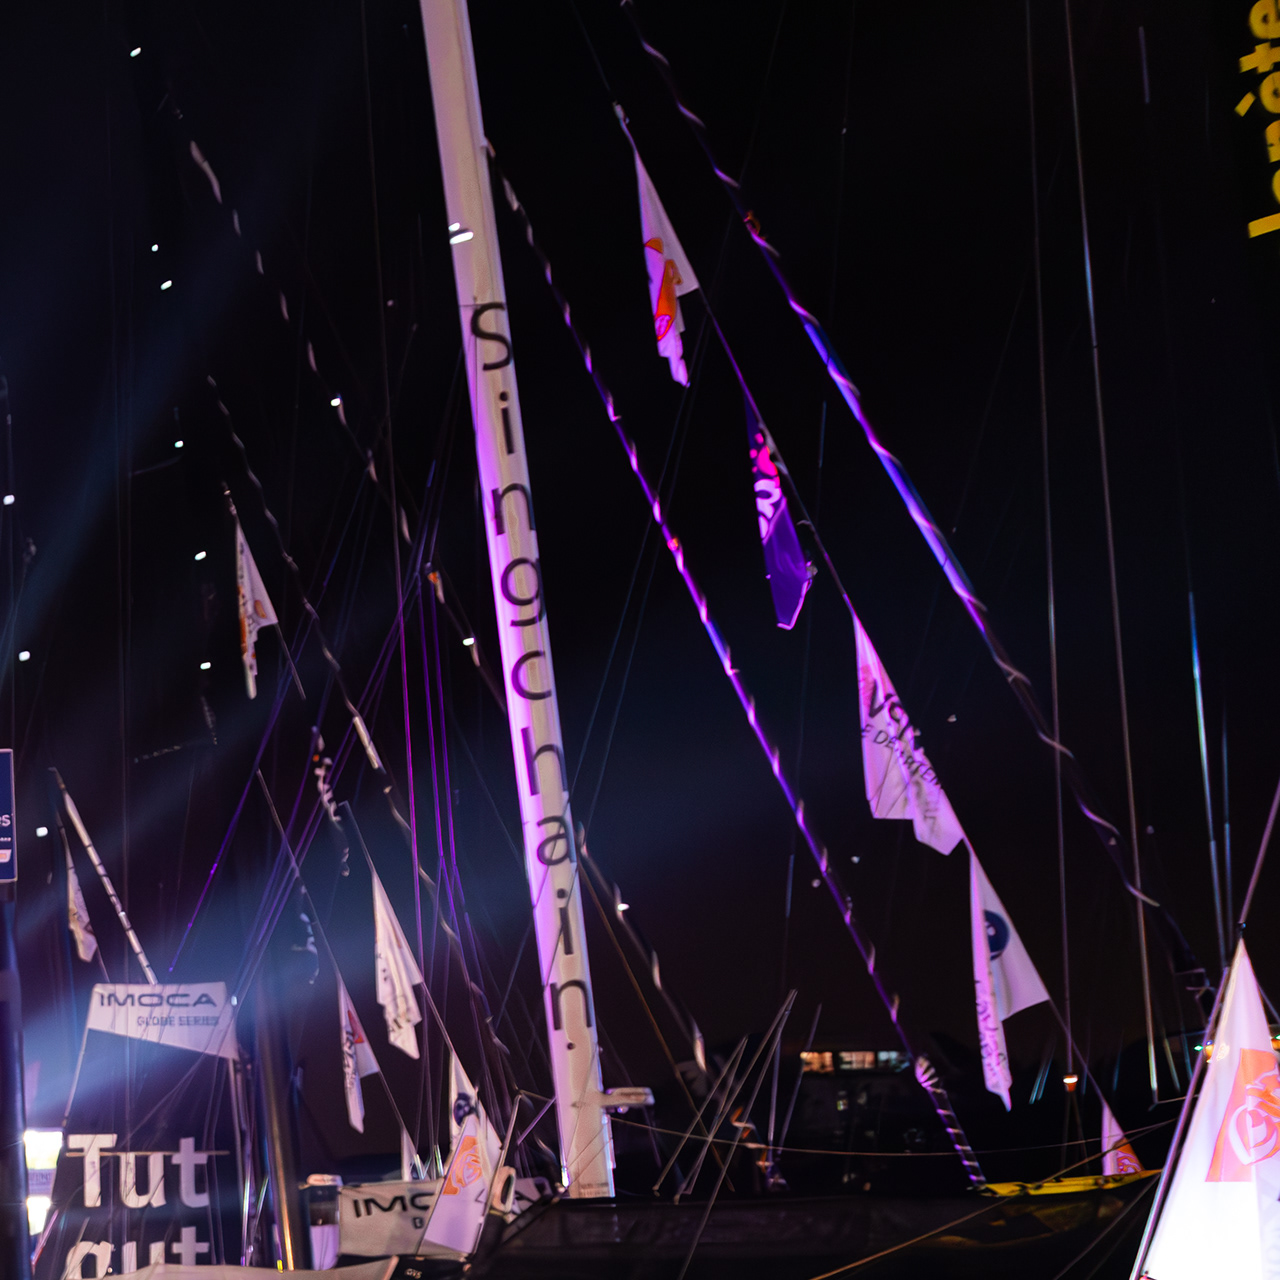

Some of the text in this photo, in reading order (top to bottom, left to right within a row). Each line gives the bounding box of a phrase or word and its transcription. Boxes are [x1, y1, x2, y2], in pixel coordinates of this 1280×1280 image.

[471, 302, 595, 1031] Singchain
[99, 992, 217, 1007] IMOCA
[68, 1133, 210, 1209] Tut
